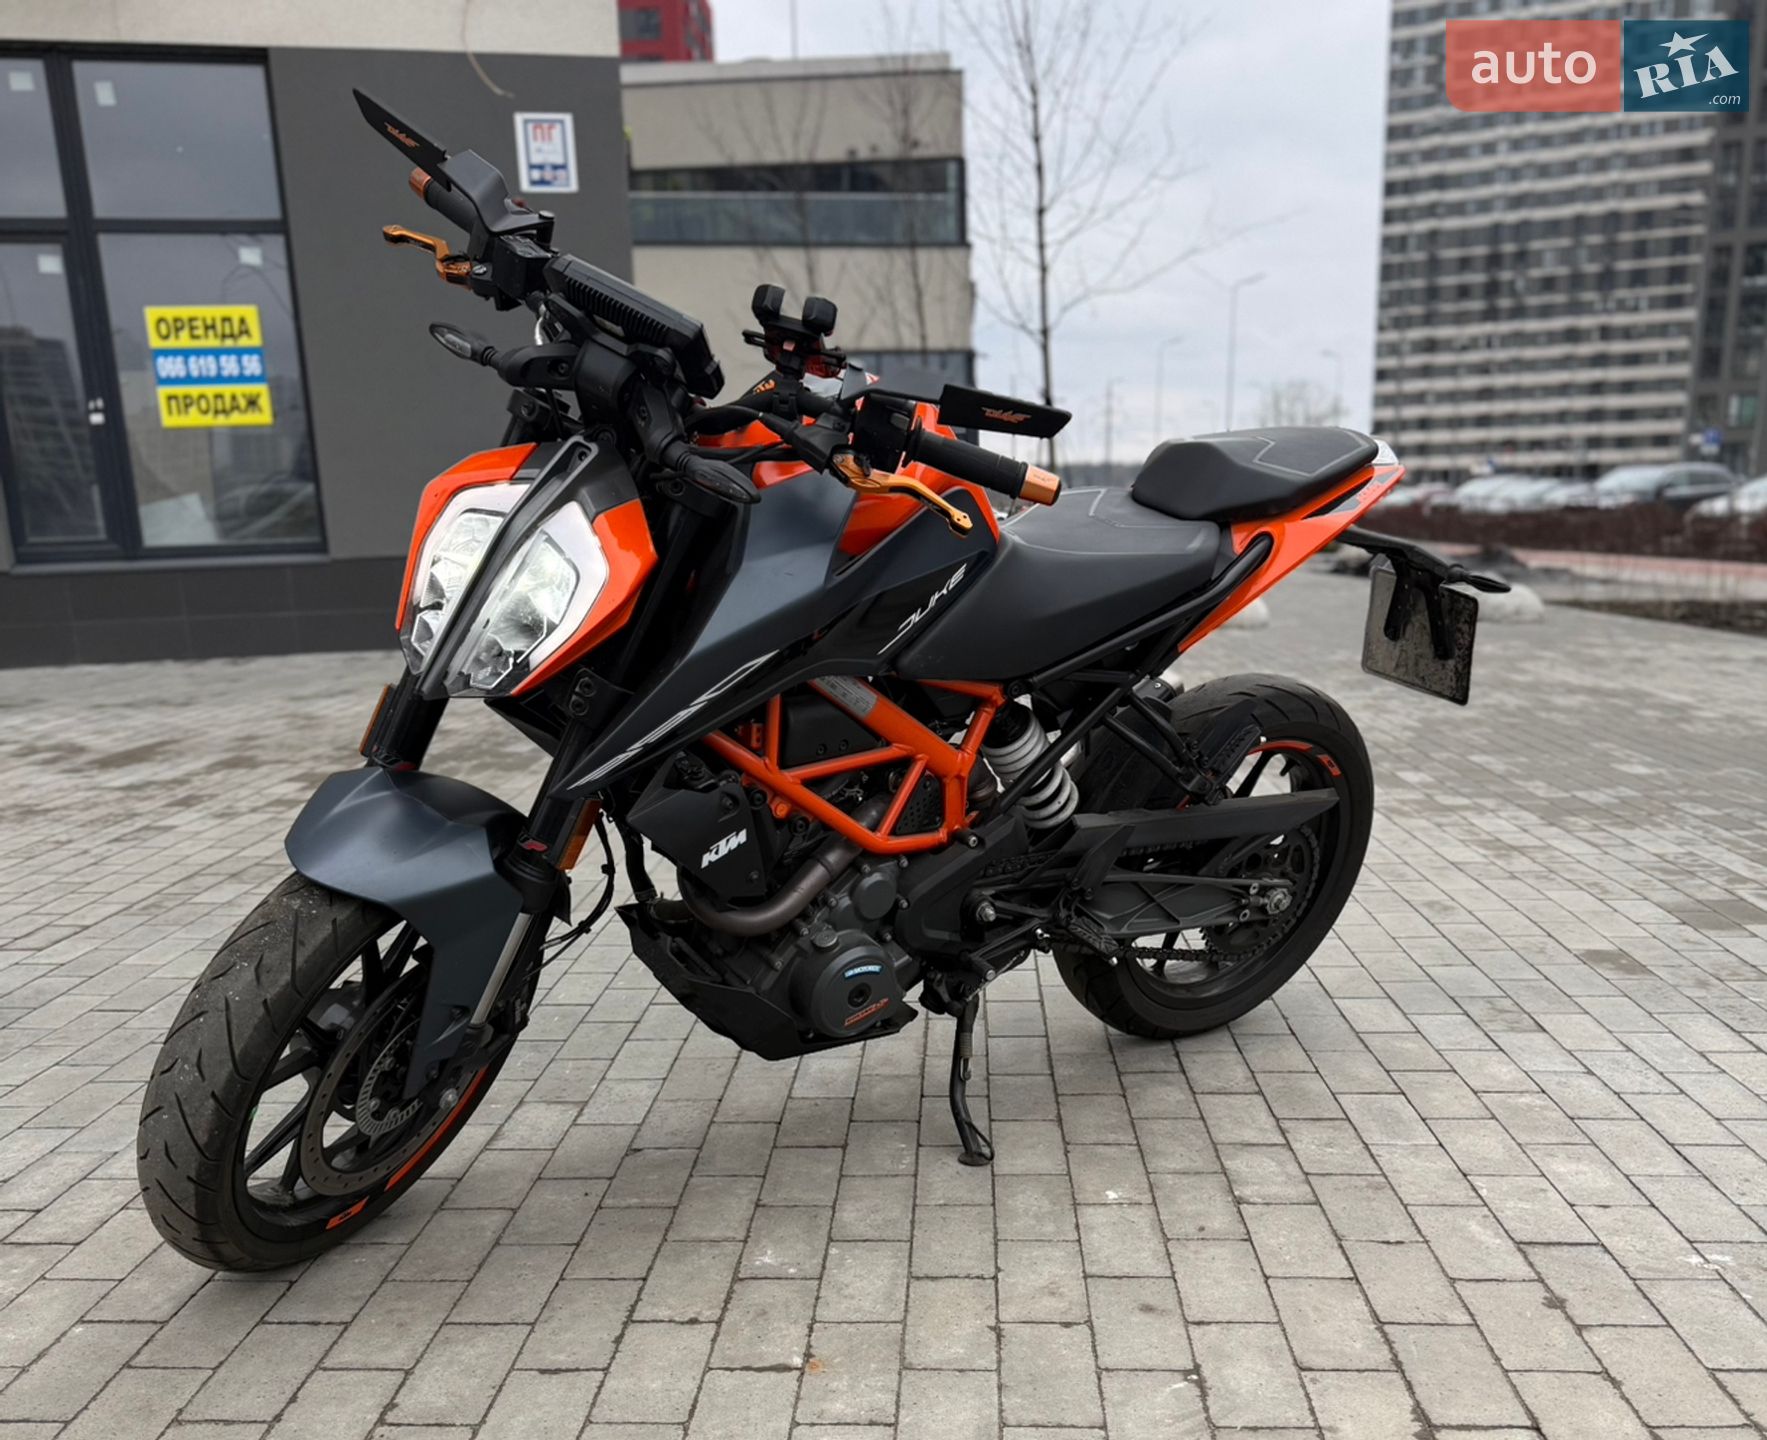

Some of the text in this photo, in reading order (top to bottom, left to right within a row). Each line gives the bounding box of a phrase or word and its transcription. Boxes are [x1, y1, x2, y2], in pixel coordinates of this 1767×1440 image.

[155, 316, 252, 345] ОРЕНДА
[165, 392, 263, 418] ПРОДАЖ
[877, 563, 967, 655] DUKE
[701, 828, 747, 869] KTM
